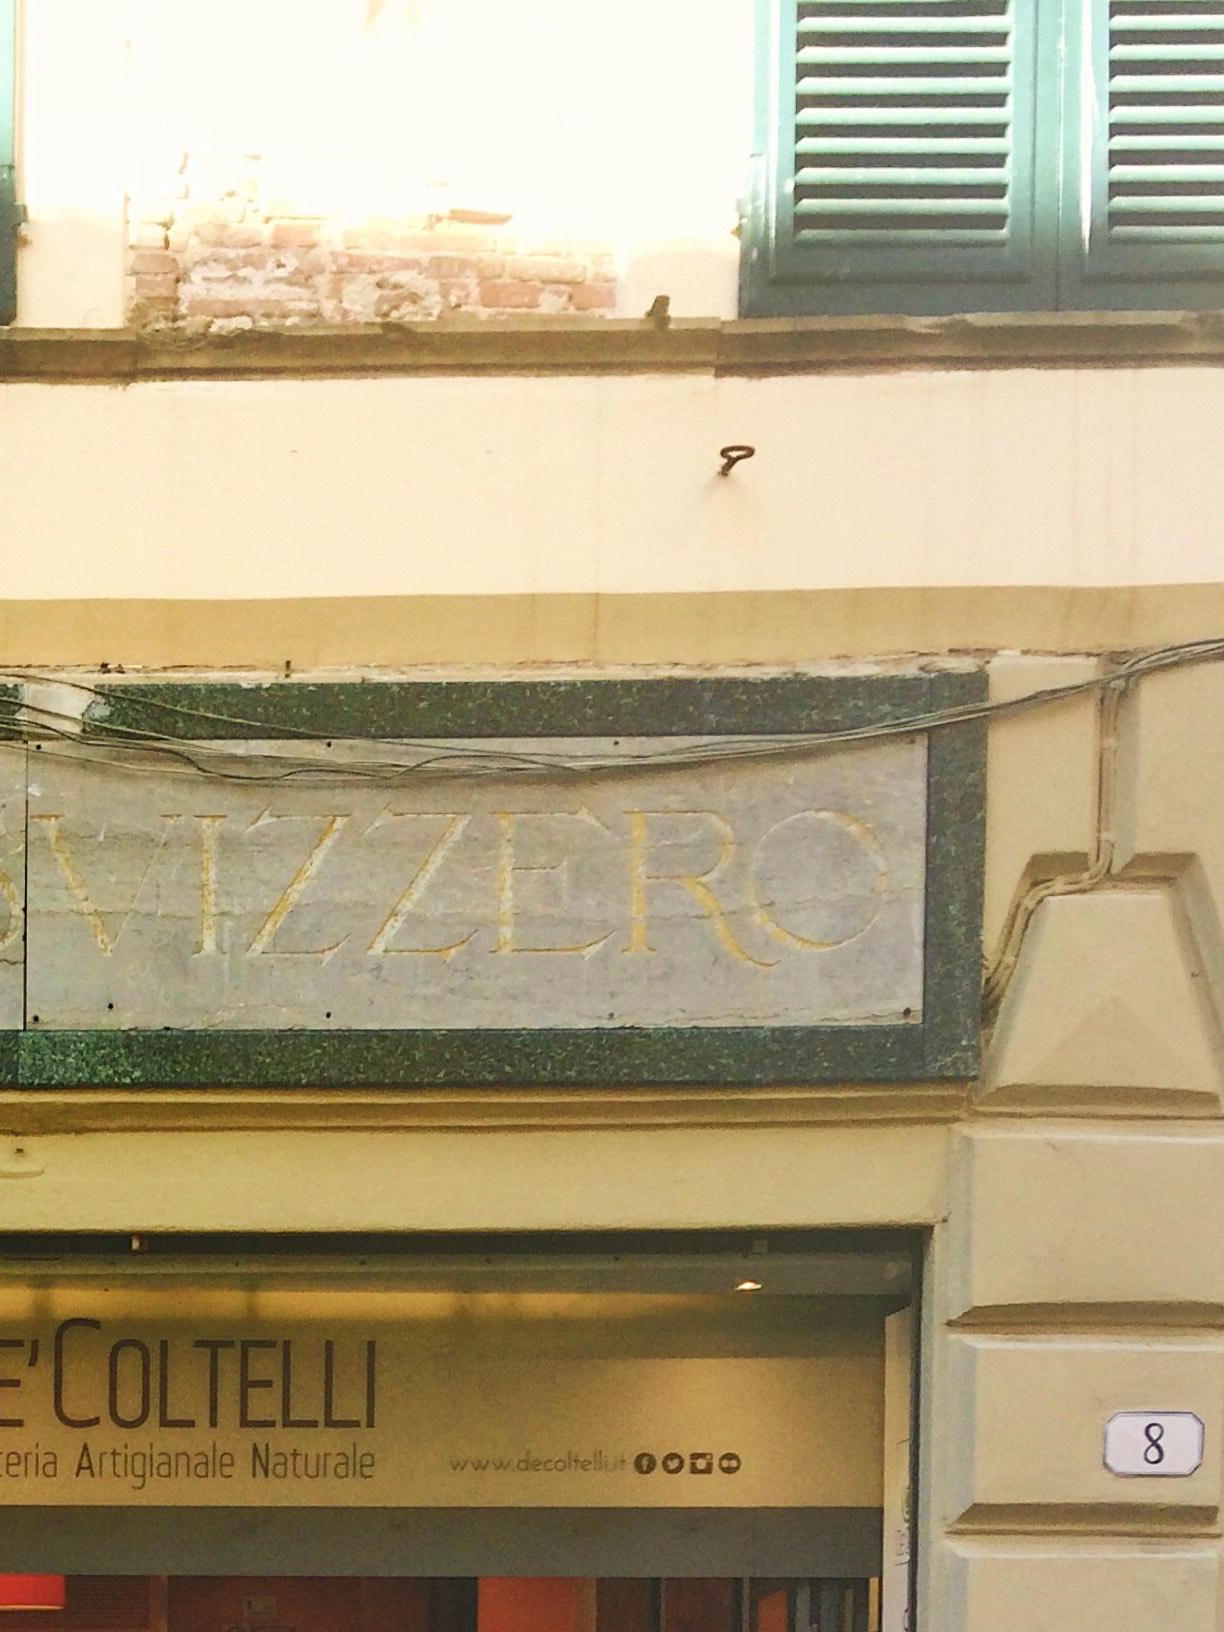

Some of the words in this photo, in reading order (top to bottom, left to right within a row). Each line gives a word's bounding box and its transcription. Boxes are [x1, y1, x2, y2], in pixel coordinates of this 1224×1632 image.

[75, 1441, 235, 1489] Artigianale
[251, 1441, 376, 1479] Naturale
[1143, 1422, 1164, 1465] 8
